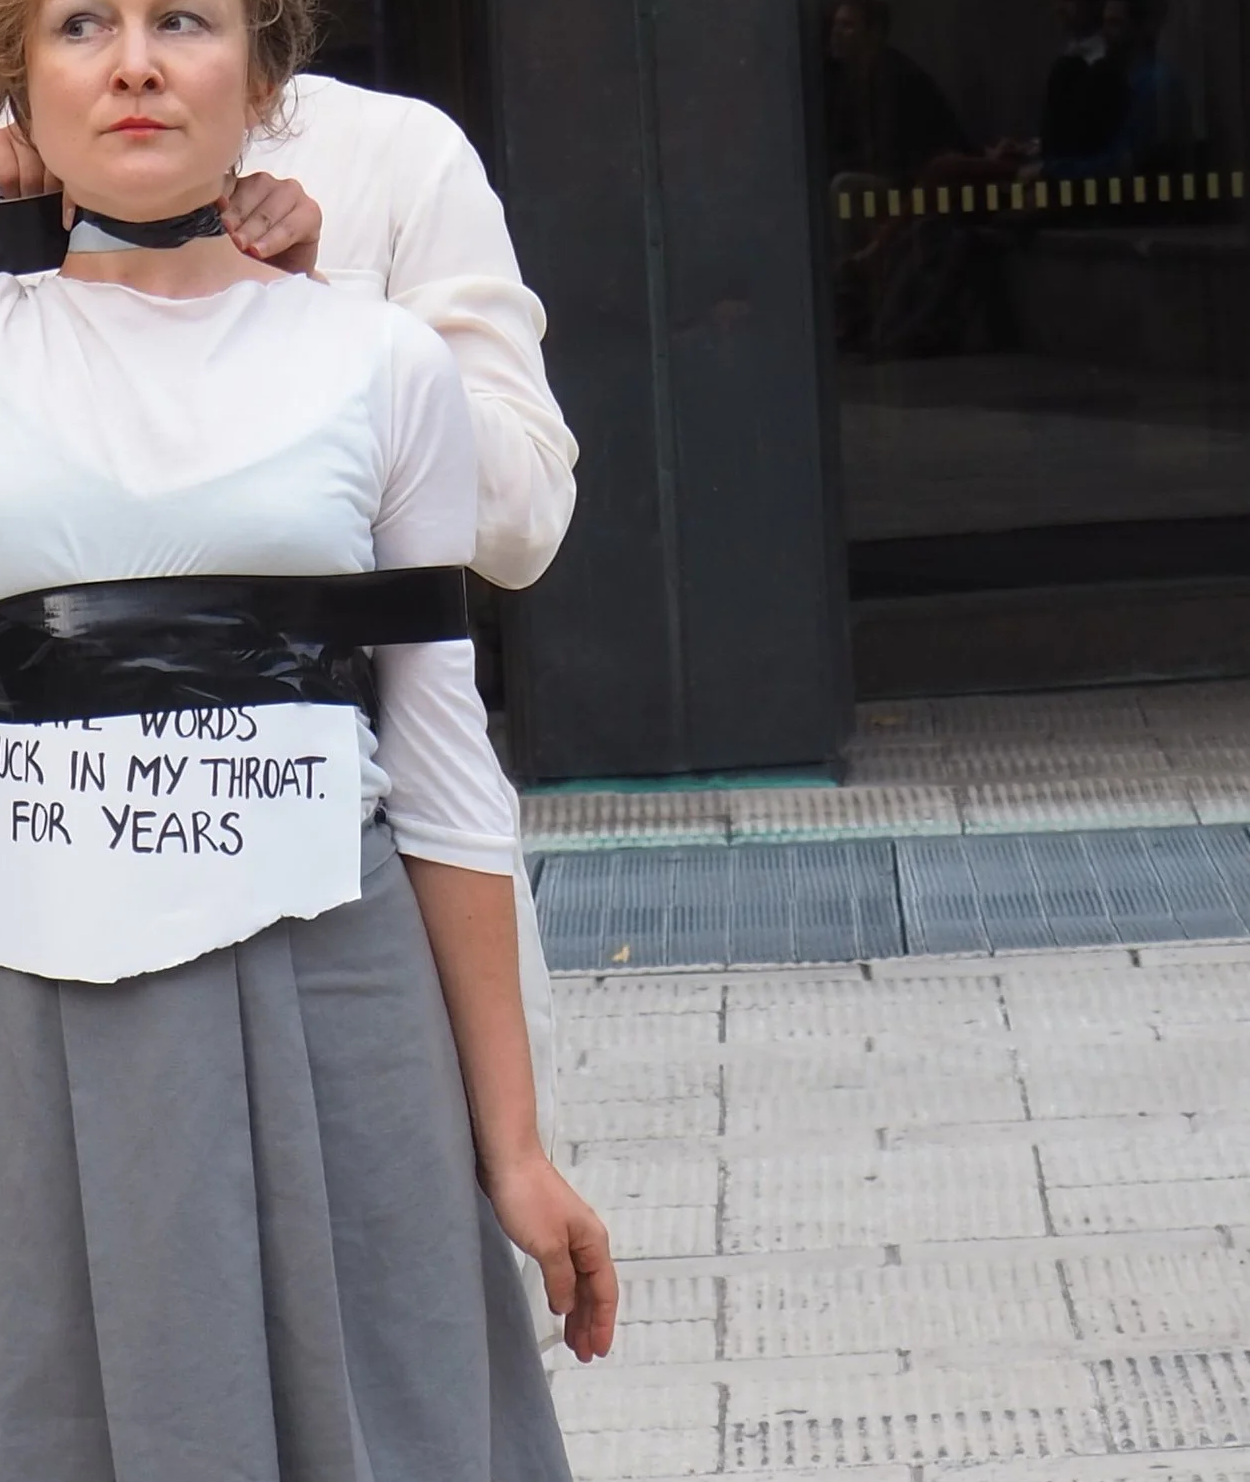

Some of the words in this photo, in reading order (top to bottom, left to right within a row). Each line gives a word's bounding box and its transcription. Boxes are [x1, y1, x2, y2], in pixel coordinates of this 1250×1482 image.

[140, 706, 257, 741] WORDS
[70, 751, 105, 792] IN
[127, 755, 188, 797] MY
[200, 756, 327, 799] THROAT.
[12, 801, 72, 845] FOR
[101, 804, 243, 855] YEARS
